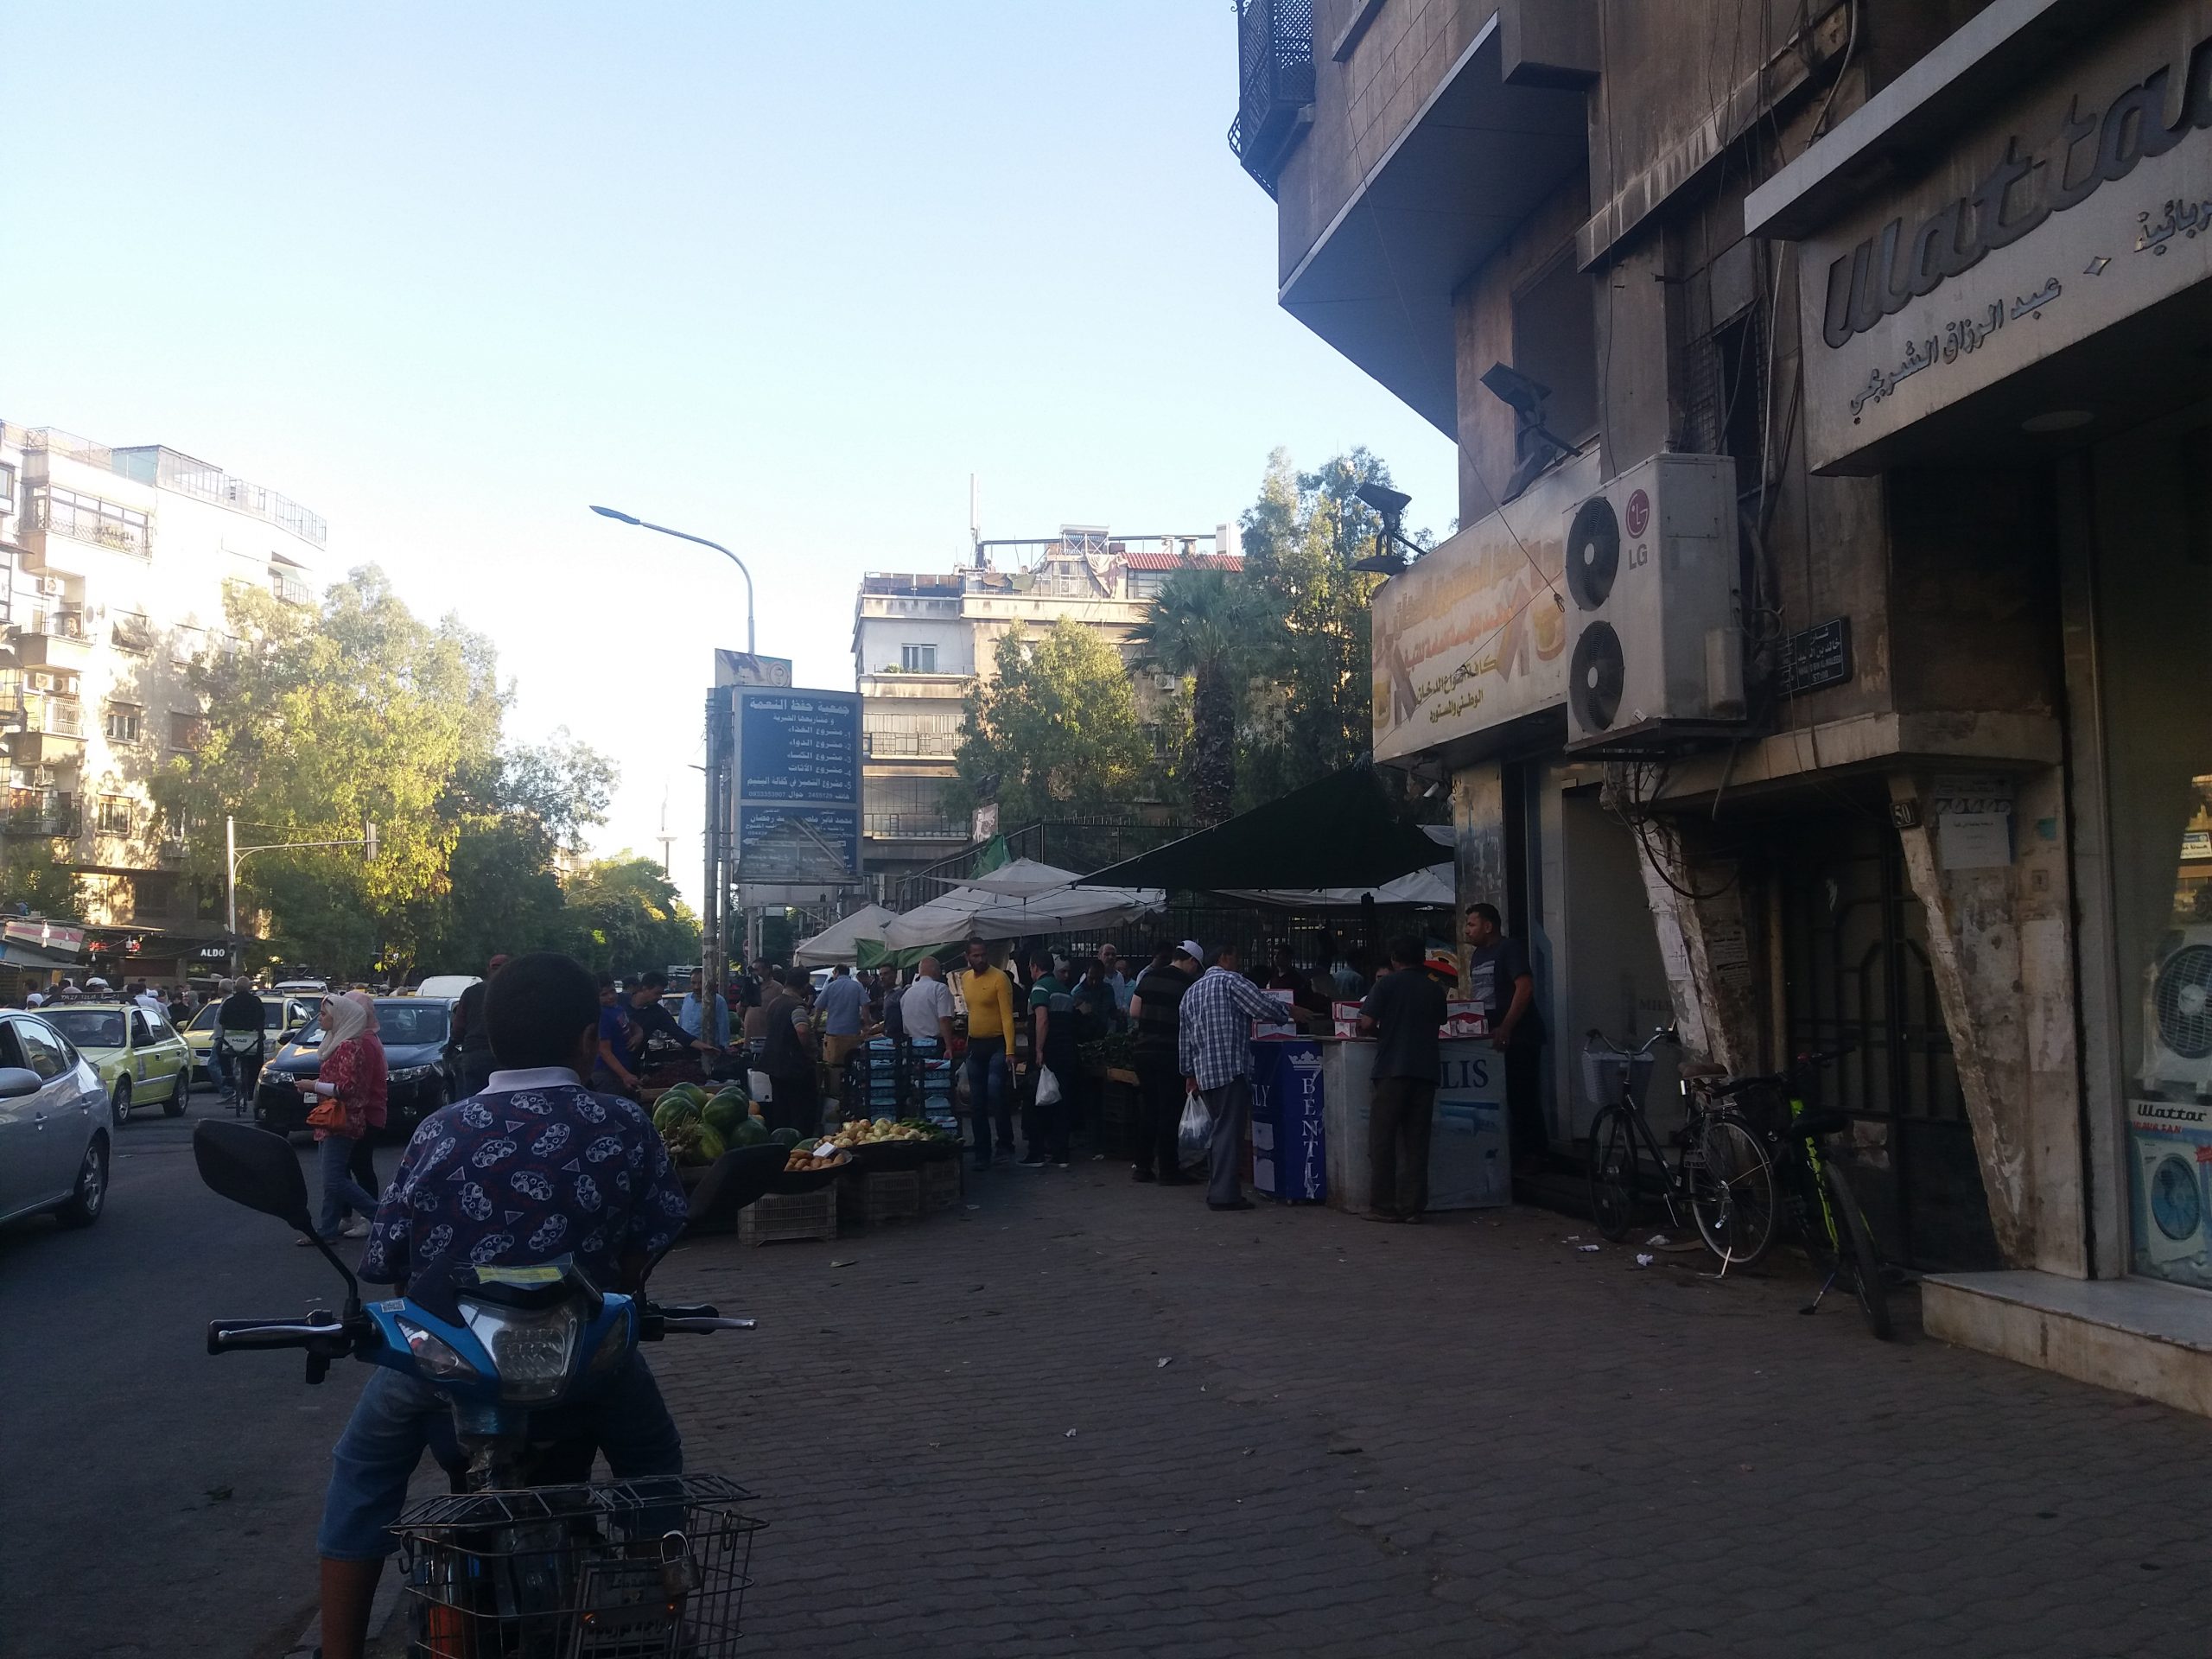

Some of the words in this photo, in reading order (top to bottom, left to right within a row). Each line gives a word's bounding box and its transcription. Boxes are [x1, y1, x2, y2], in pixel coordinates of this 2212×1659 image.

[2010, 276, 2063, 321] عبد
[1942, 297, 2004, 365] الرزاق
[1628, 543, 1648, 570] LG
[749, 697, 787, 710] النعمة
[791, 699, 813, 712] حفظ
[817, 701, 850, 716] جمعية
[1457, 688, 1484, 716] الوطني
[816, 728, 843, 736] مشروع
[816, 741, 843, 750] مشروع
[816, 753, 843, 762] مشروع
[816, 766, 843, 775] مشروع
[822, 779, 843, 789] مشروع
[1894, 804, 1910, 825] 50
[200, 949, 226, 957] ALDO
[1440, 1059, 1489, 1090] LIS
[2138, 1104, 2207, 1122] Wattar
[1301, 1077, 1320, 1200] BENTLY
